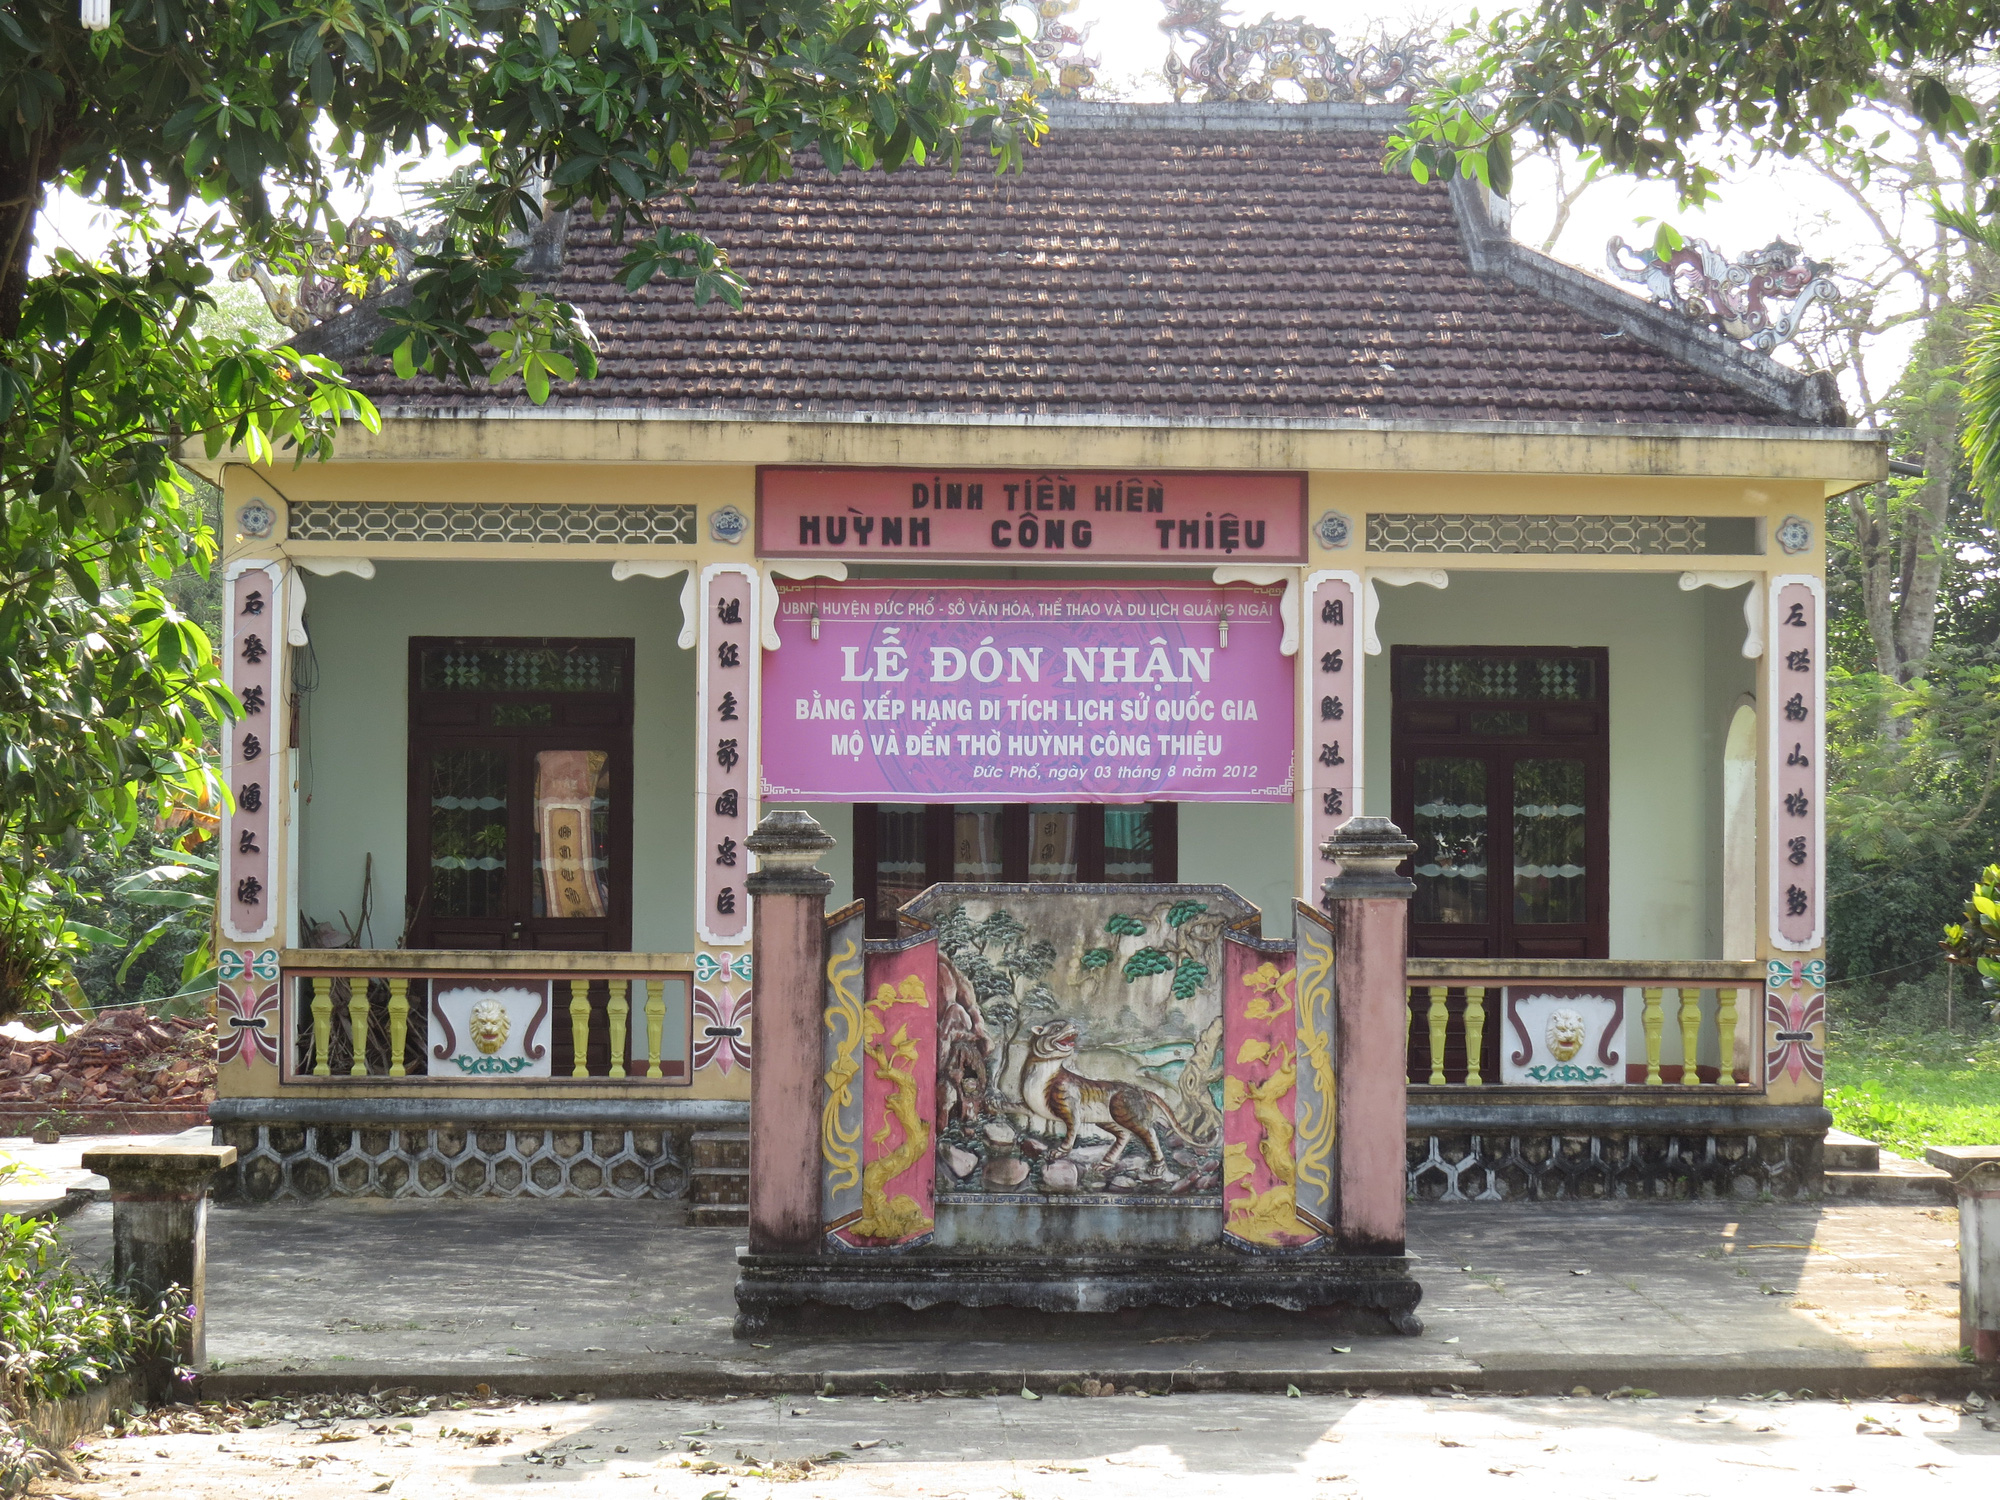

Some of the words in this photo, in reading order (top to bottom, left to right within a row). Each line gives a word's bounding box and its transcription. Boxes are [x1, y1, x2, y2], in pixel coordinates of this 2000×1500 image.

[1003, 475, 1076, 511] TIỀN
[799, 506, 930, 546] HUỲNH
[991, 511, 1093, 549] CÔNG
[1155, 511, 1266, 554] THIỆU
[823, 600, 869, 616] HUYỆN
[875, 599, 903, 615] ĐỨC
[909, 597, 935, 615] PHỔ
[948, 598, 965, 616] SỞ
[969, 600, 998, 616] VĂN
[1002, 600, 1034, 617] HÓA,
[1038, 598, 1062, 616] THỂ
[1066, 603, 1100, 616] THAO
[1104, 600, 1123, 616] VÀ
[1127, 603, 1146, 616] DU
[1150, 603, 1178, 618] LỊCH
[1183, 599, 1235, 616] QUẢNG
[1238, 601, 1273, 616] NGÃI
[841, 627, 909, 682] LỄ
[930, 636, 1043, 682] ĐÓN
[1062, 636, 1214, 691] NHẬN
[796, 690, 855, 720] BẰNG
[863, 690, 905, 720] XẾP
[911, 699, 972, 727] HẠNG
[979, 700, 1000, 720] DI
[1007, 694, 1057, 721] TÍCH
[1065, 700, 1114, 727] LỊCH
[1120, 692, 1150, 721] SỬ
[1155, 691, 1215, 722] QUỐC
[1221, 700, 1258, 721] GIA
[831, 729, 864, 762] MỘ
[870, 728, 899, 756] VÀ
[906, 726, 950, 756] ĐỀN
[957, 729, 1001, 756] THỜ
[1009, 729, 1083, 756] HUỲNH
[1090, 731, 1150, 757] CÔNG
[1158, 730, 1222, 761] THIỆU
[973, 764, 1003, 778] Đức
[1009, 763, 1041, 780] Phổ,
[1048, 765, 1088, 781] ngày
[1094, 766, 1111, 778] 03
[1118, 766, 1161, 780] tháng
[1167, 766, 1176, 778] 8
[1182, 765, 1216, 778] năm
[1222, 766, 1258, 778] 2012
